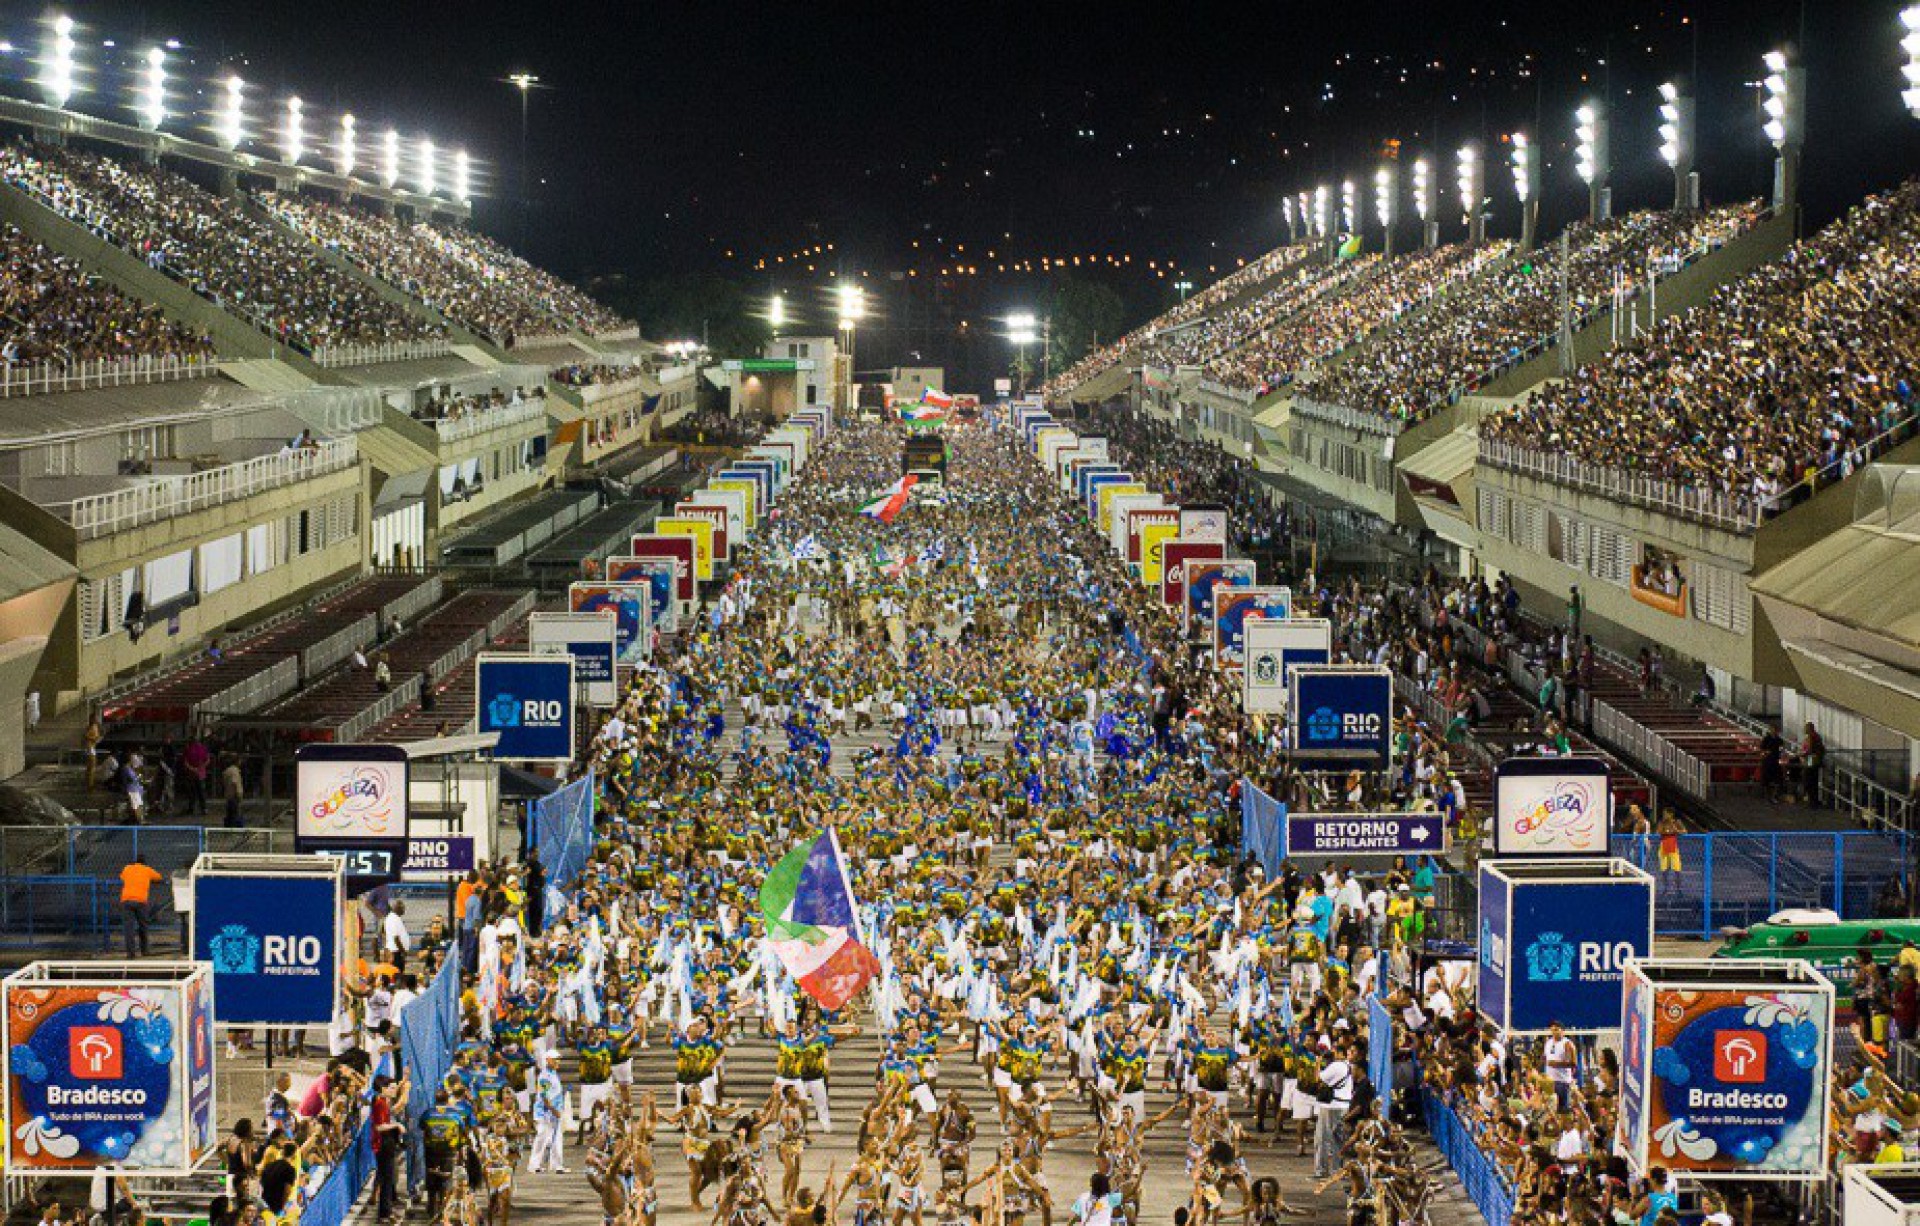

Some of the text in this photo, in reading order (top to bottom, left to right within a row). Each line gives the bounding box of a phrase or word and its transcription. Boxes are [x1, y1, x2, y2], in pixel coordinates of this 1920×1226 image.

[524, 700, 561, 720] RIO
[1343, 713, 1380, 733] RIO
[1314, 821, 1400, 837] RETORNO
[408, 841, 449, 855] RNO
[1315, 837, 1399, 848] DESFILANTES
[402, 856, 449, 867] ANTES
[264, 935, 320, 965] RIO
[1579, 942, 1635, 971] RIO
[47, 1085, 146, 1105] Bradesco
[1689, 1088, 1787, 1109] Bradesco
[50, 1112, 70, 1121] Tudo
[72, 1112, 82, 1121] de
[84, 1112, 102, 1121] BRA
[104, 1113, 123, 1122] para
